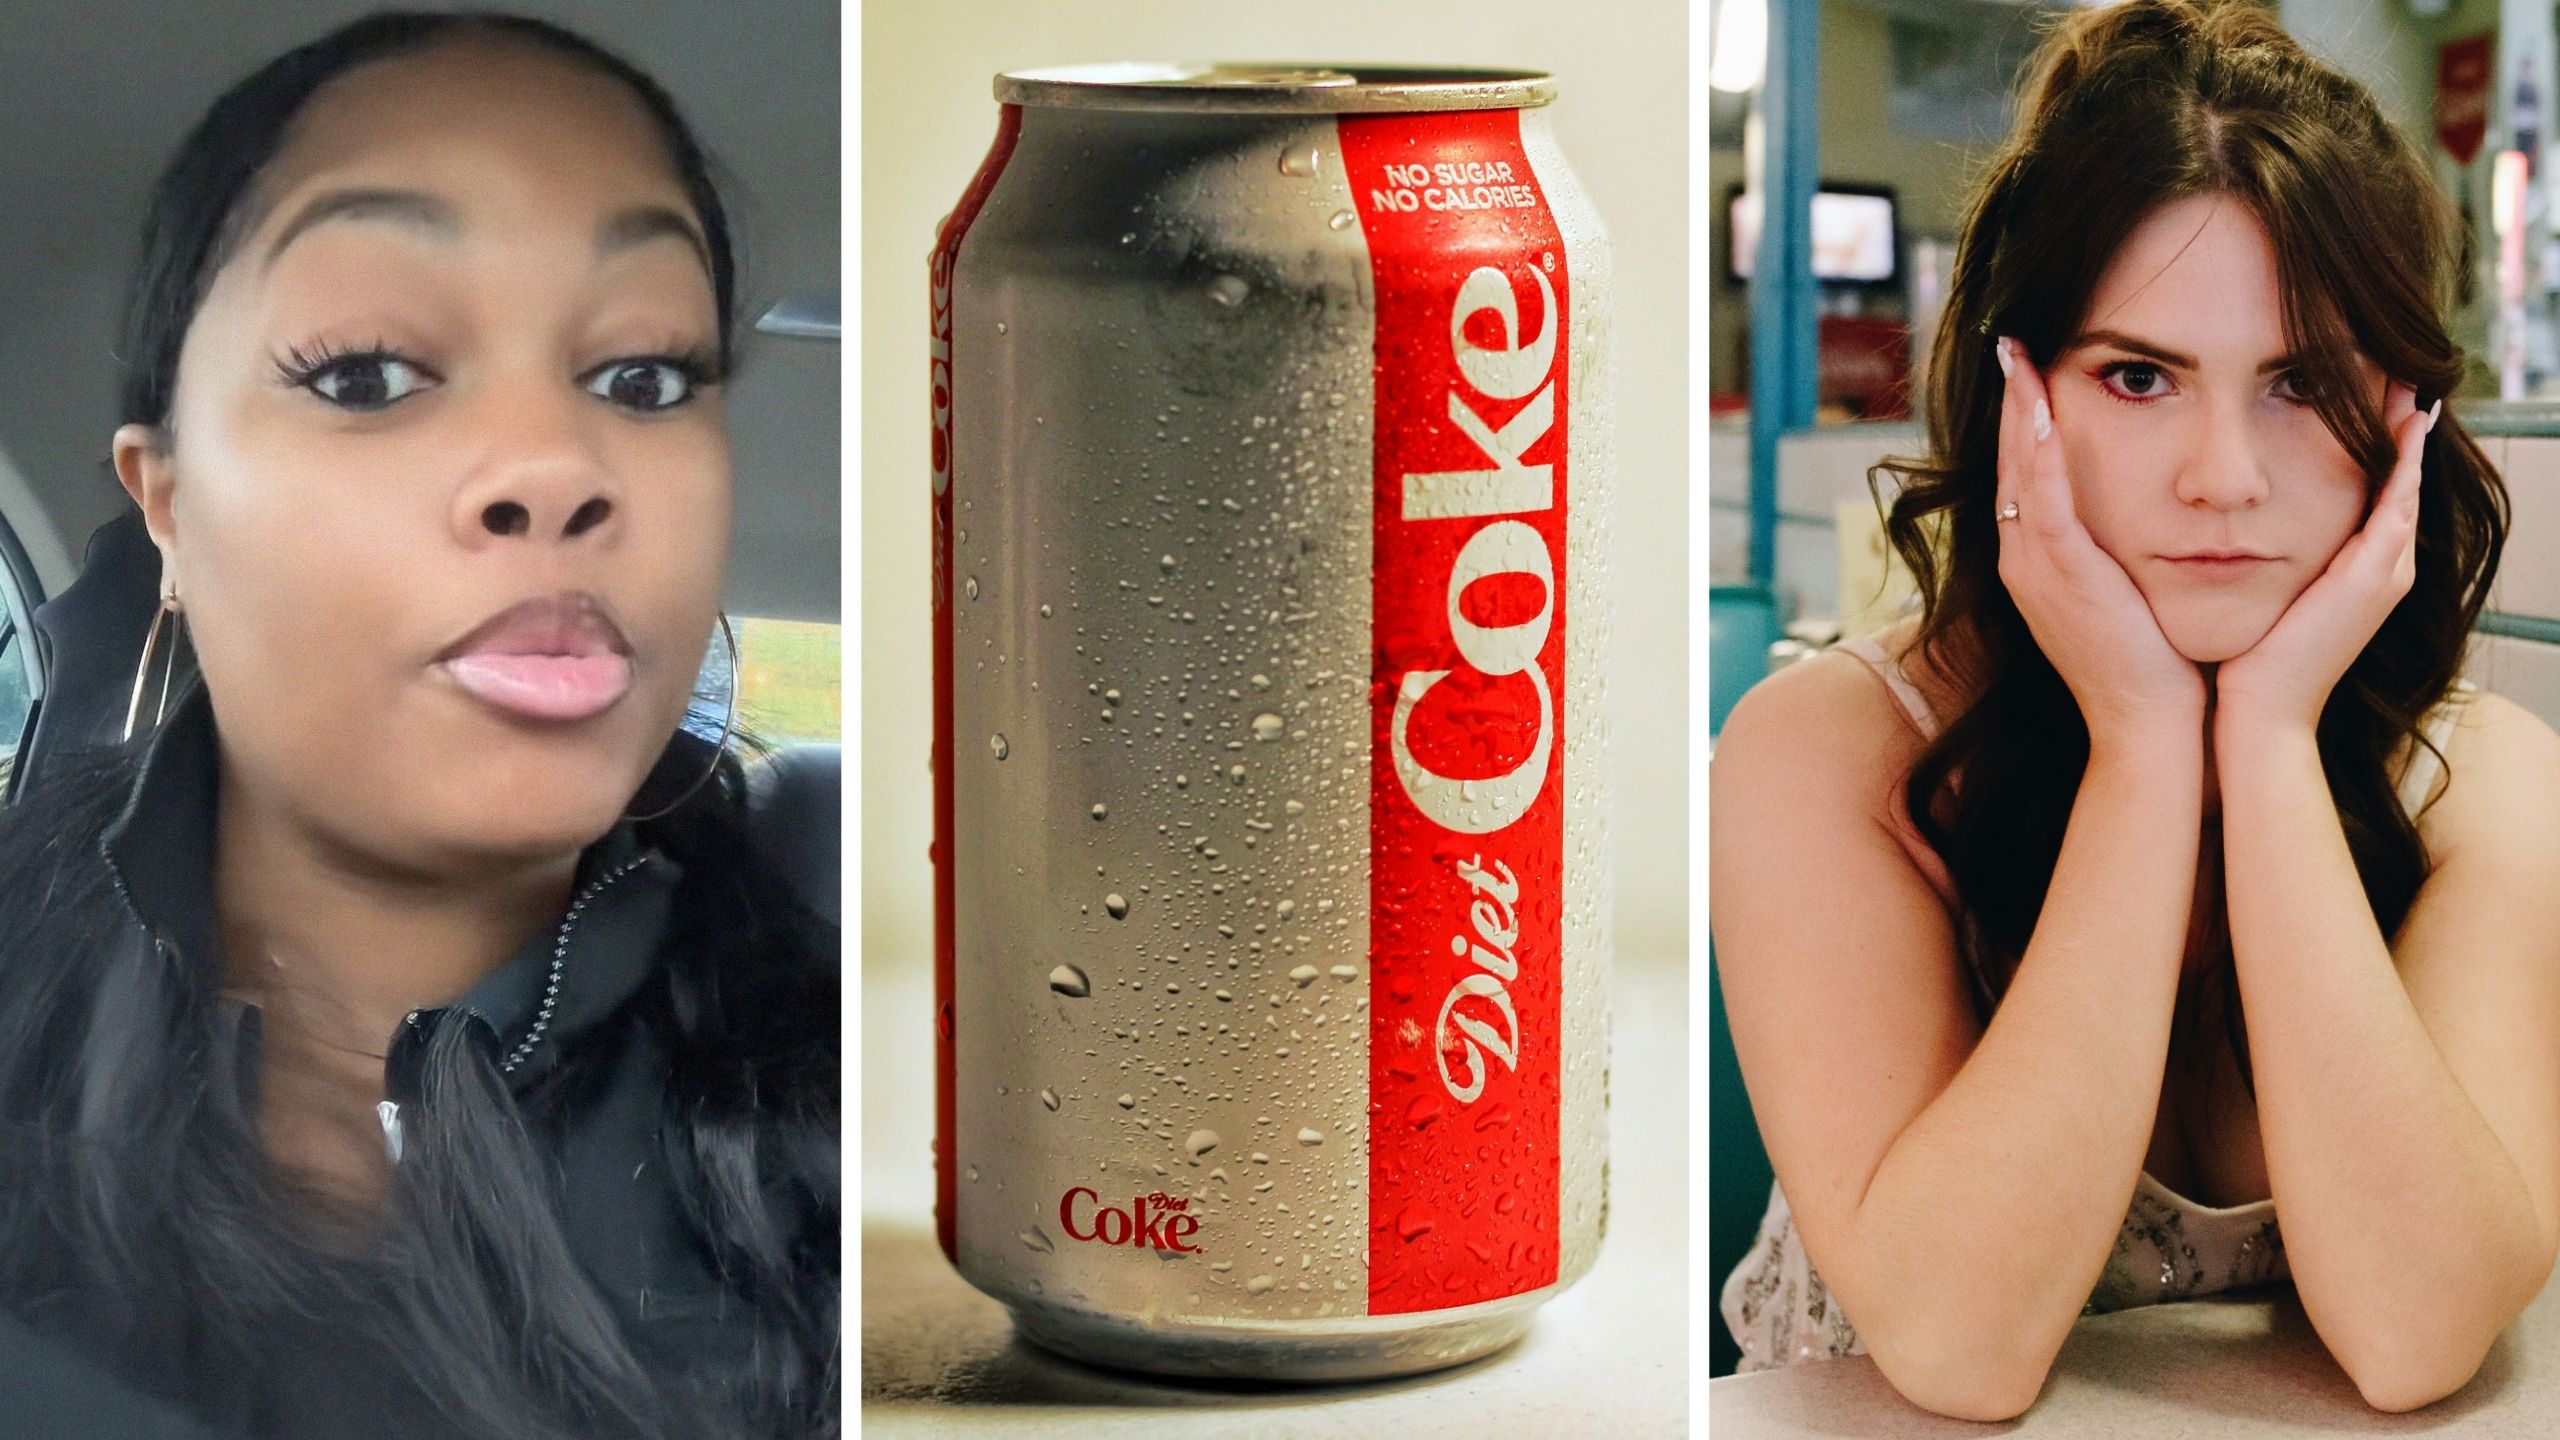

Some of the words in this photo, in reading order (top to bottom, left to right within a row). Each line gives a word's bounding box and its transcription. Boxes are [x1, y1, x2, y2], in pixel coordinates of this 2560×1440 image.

[1384, 164, 1430, 187] NO
[1434, 162, 1515, 186] SUGAR
[1372, 189, 1419, 212] NO
[1424, 185, 1536, 212] CALORIES
[1435, 853, 1519, 1104] Diet
[1147, 1191, 1189, 1212] Diet
